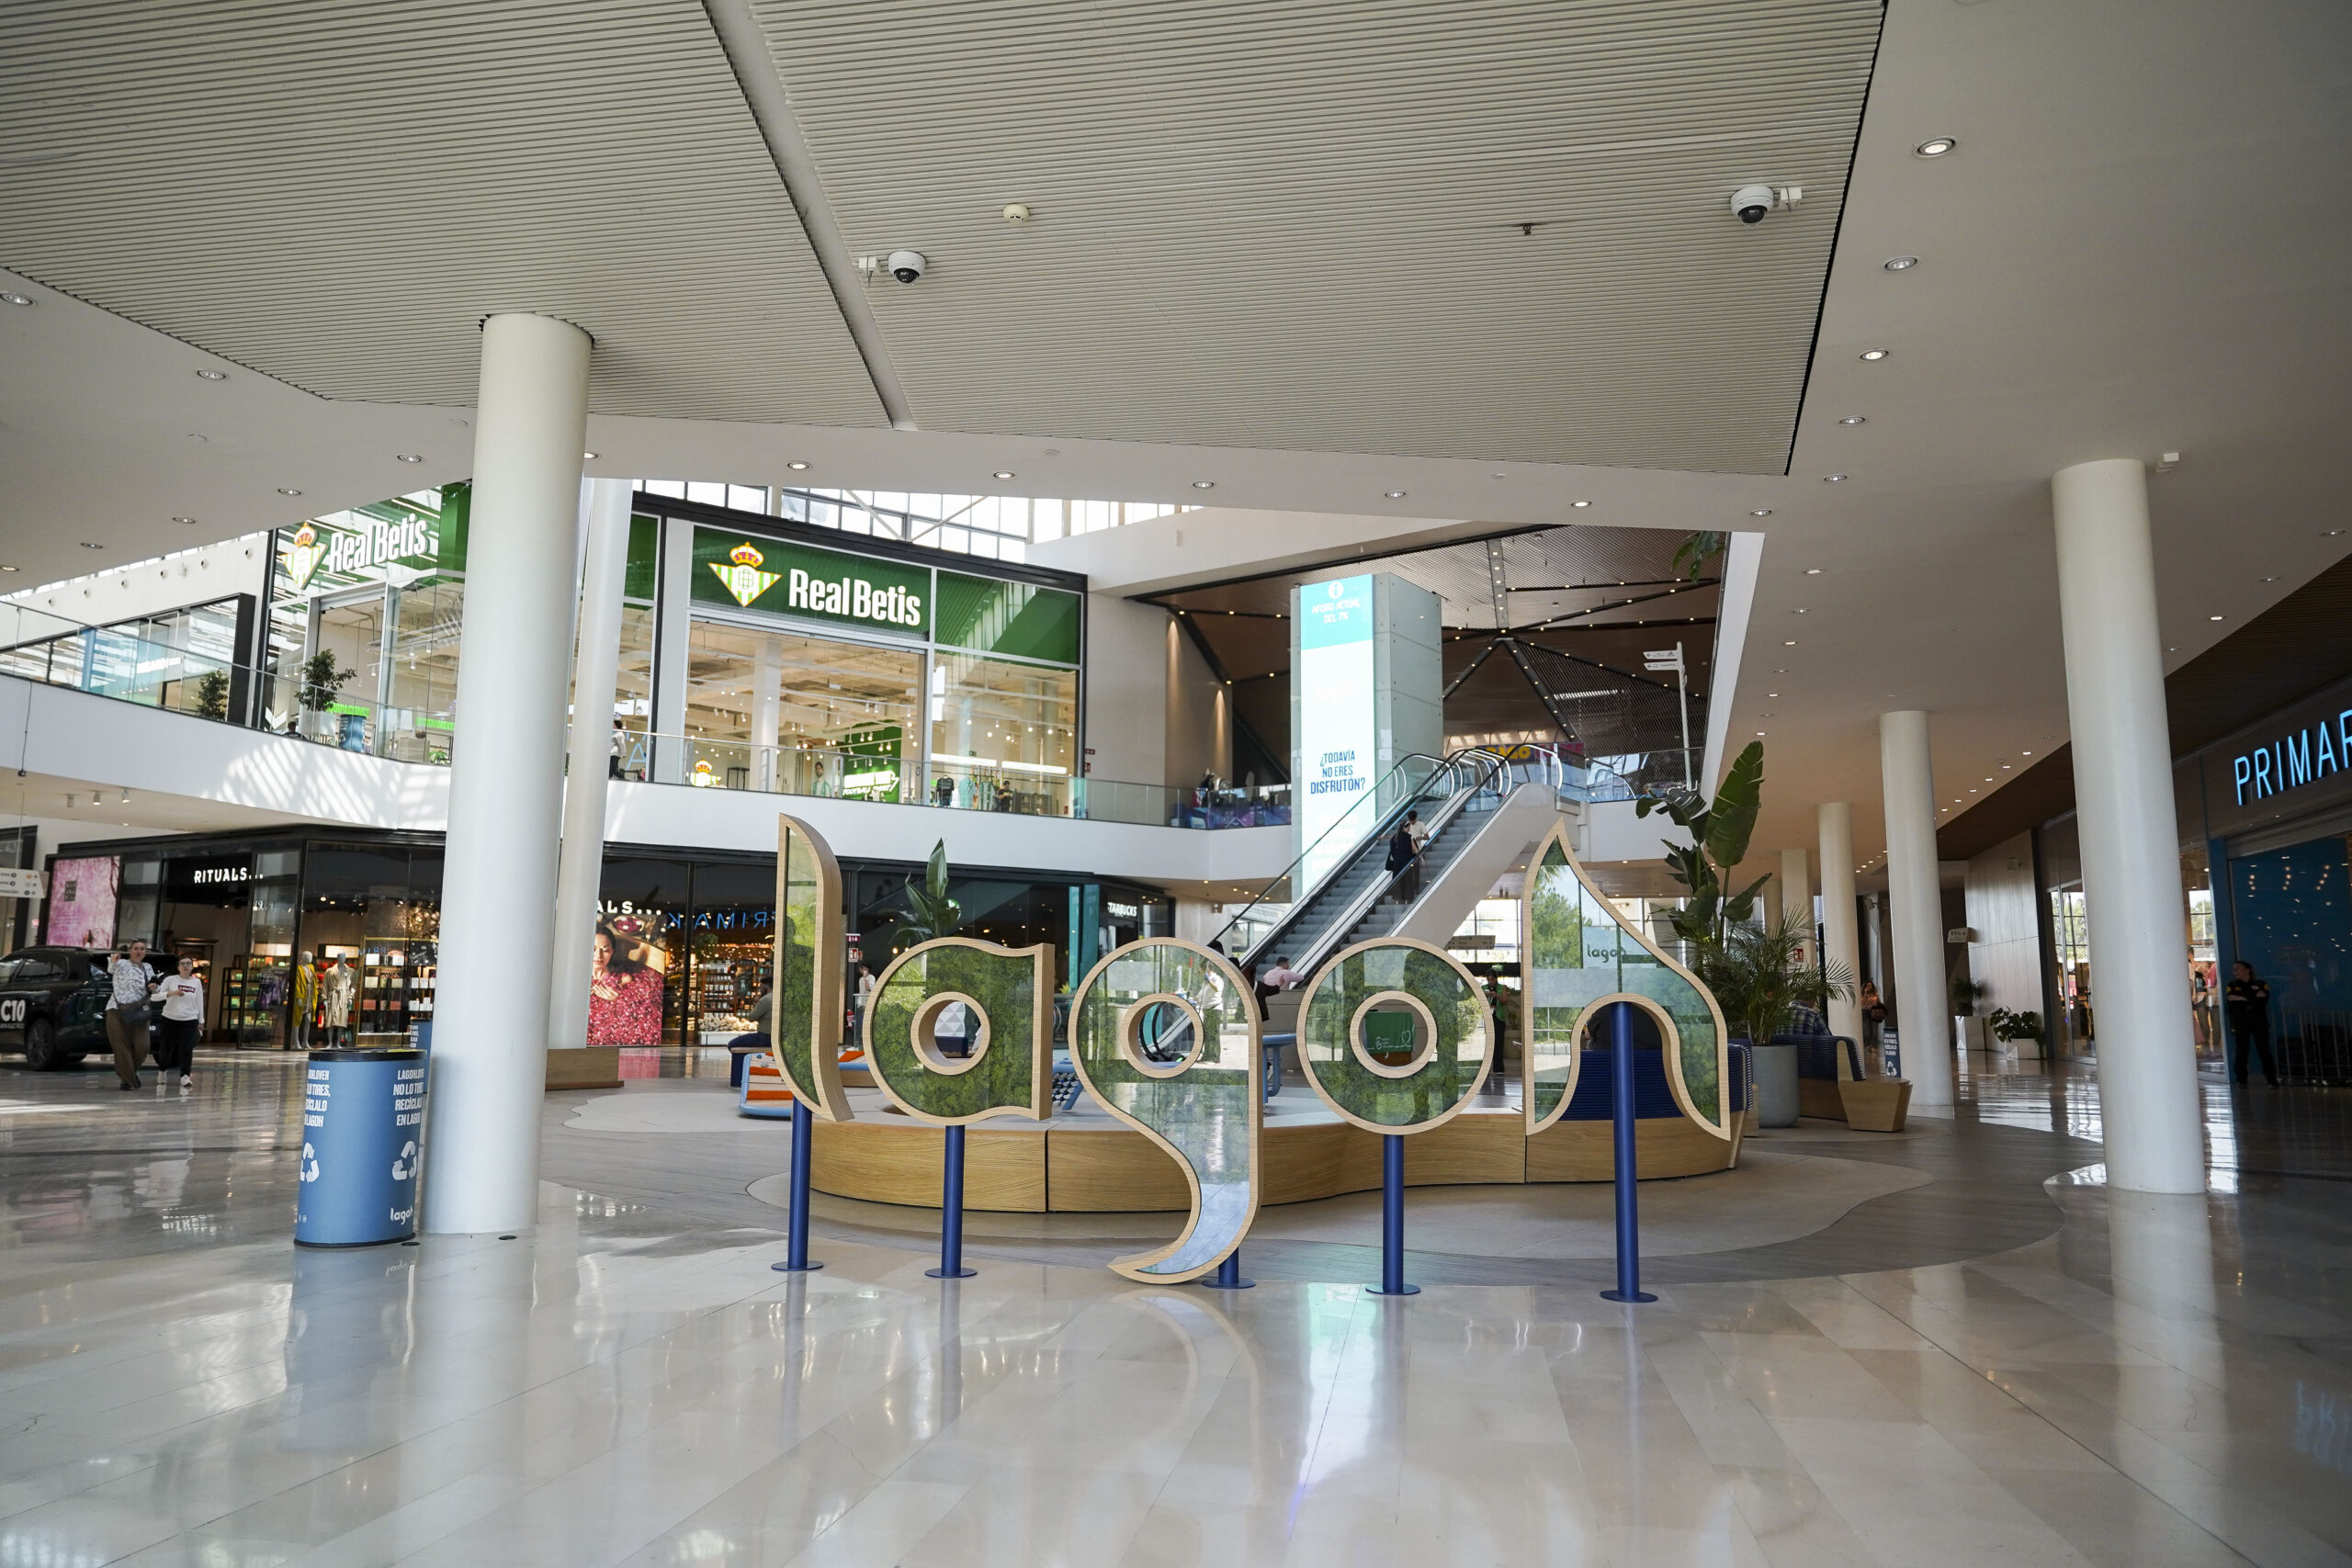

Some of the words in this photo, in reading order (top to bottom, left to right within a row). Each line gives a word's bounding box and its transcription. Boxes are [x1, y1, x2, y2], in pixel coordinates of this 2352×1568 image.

[328, 525, 376, 573] Real
[374, 513, 428, 563] Betis
[788, 568, 851, 615] Real
[853, 579, 922, 626] Betis
[1320, 750, 1356, 767] ¿TODAVÍA
[1322, 767, 1333, 778] NO
[1334, 765, 1353, 777] ERES
[1310, 776, 1366, 795] DISFRUTÓN?
[194, 867, 264, 884] RITUALS...
[1107, 901, 1137, 917] STARBUCKS
[1, 999, 26, 1021] C10
[775, 813, 1730, 1285] lagoh
[393, 1084, 405, 1096] NO
[405, 1083, 413, 1095] LO
[396, 1114, 407, 1126] EN
